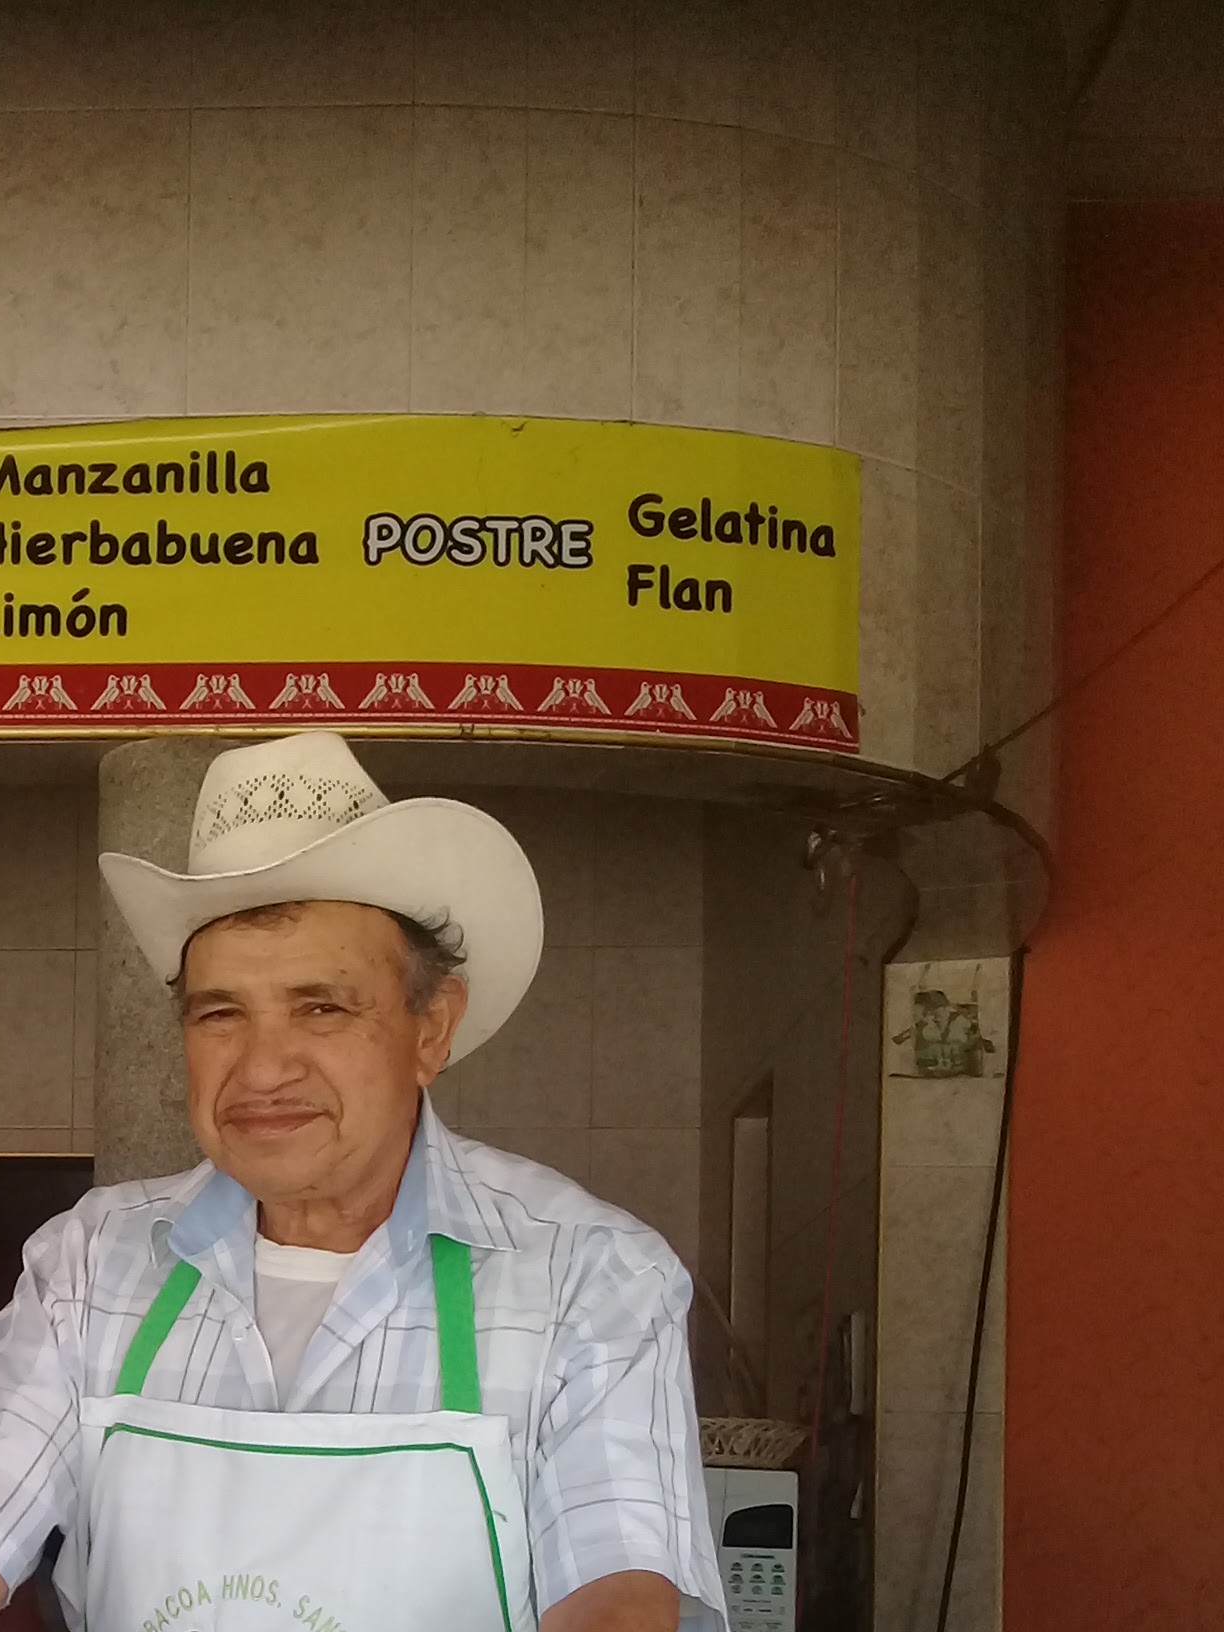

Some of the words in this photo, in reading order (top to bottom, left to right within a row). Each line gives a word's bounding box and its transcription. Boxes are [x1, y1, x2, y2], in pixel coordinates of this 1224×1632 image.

[362, 512, 595, 570] POSTRE
[628, 493, 837, 557] Gelatina
[626, 563, 733, 613] Flan
[222, 1573, 282, 1608] HNOS.
